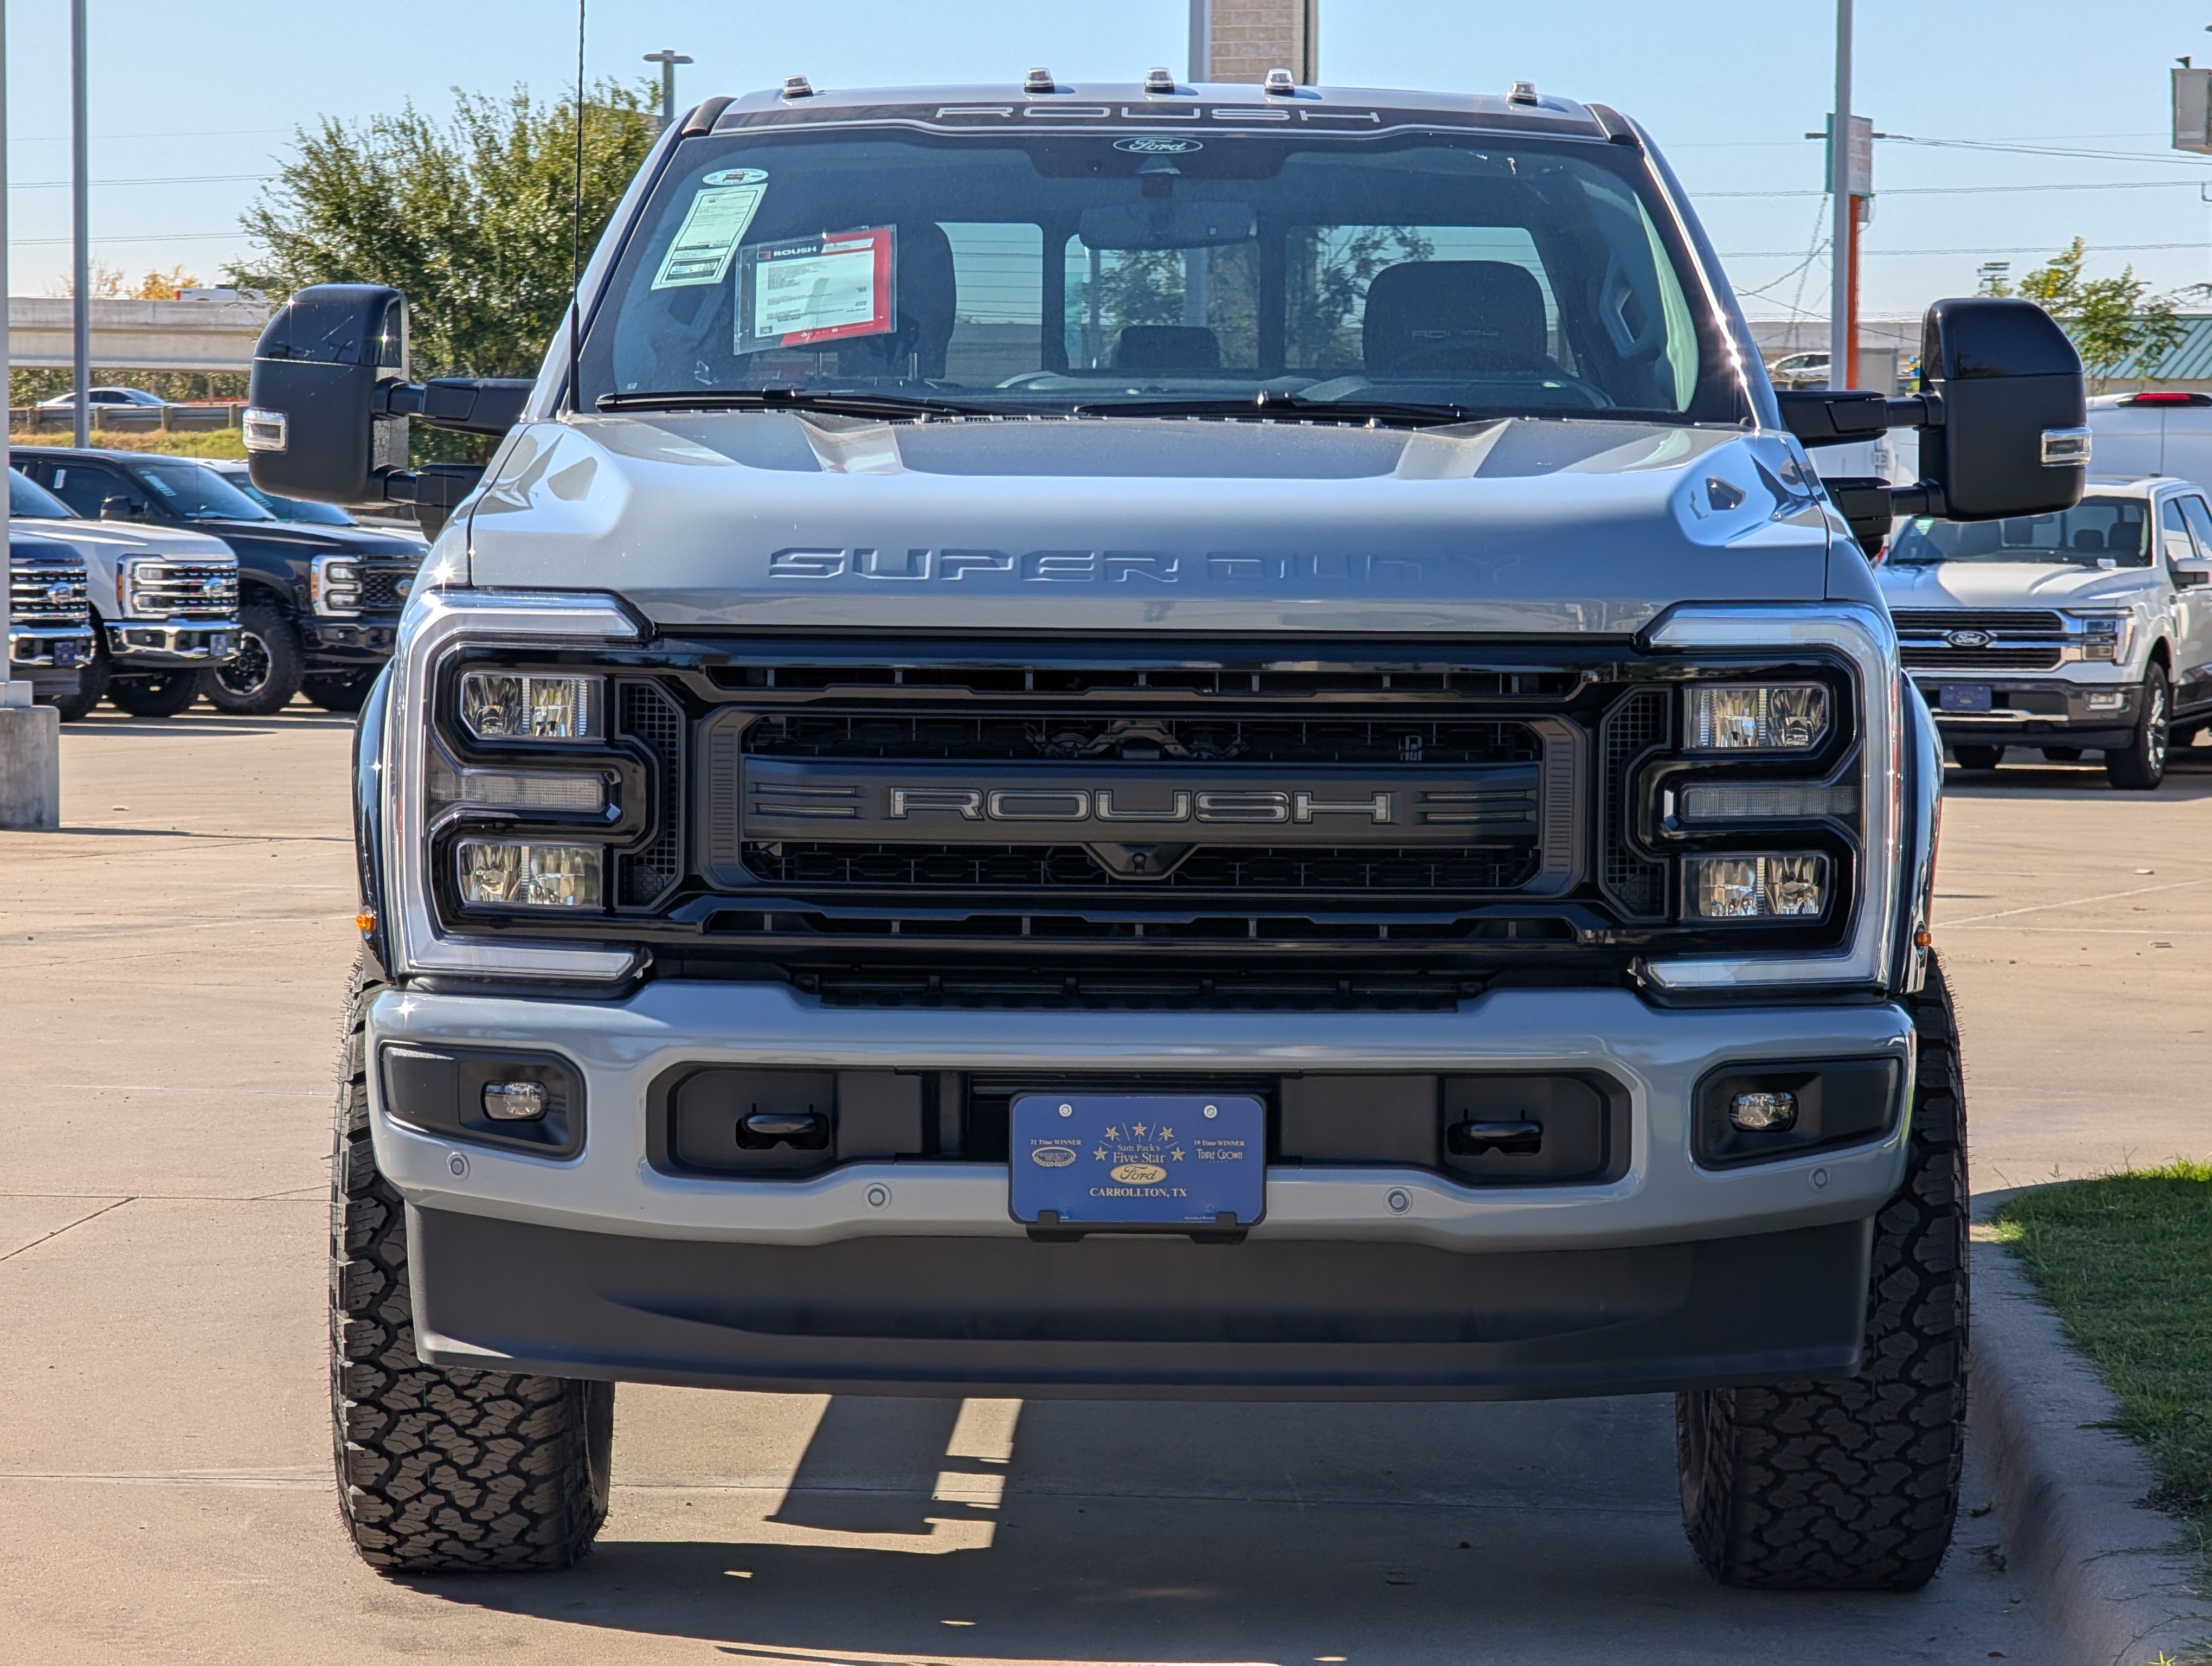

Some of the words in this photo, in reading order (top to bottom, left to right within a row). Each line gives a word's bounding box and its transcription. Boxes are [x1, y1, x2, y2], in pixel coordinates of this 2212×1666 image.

[935, 107, 1381, 123] ROUSH
[1128, 138, 1188, 151] Ford
[773, 246, 817, 257] ROUSH
[768, 547, 1178, 582] SUPER
[1206, 552, 1519, 584] DUTY
[888, 787, 1392, 824] ROUSH
[1113, 1152, 1139, 1163] Five
[1141, 1152, 1166, 1163] Star
[1120, 1165, 1158, 1180] Ford
[1090, 1188, 1170, 1198] CARROLLTON,
[1171, 1188, 1187, 1197] TX
